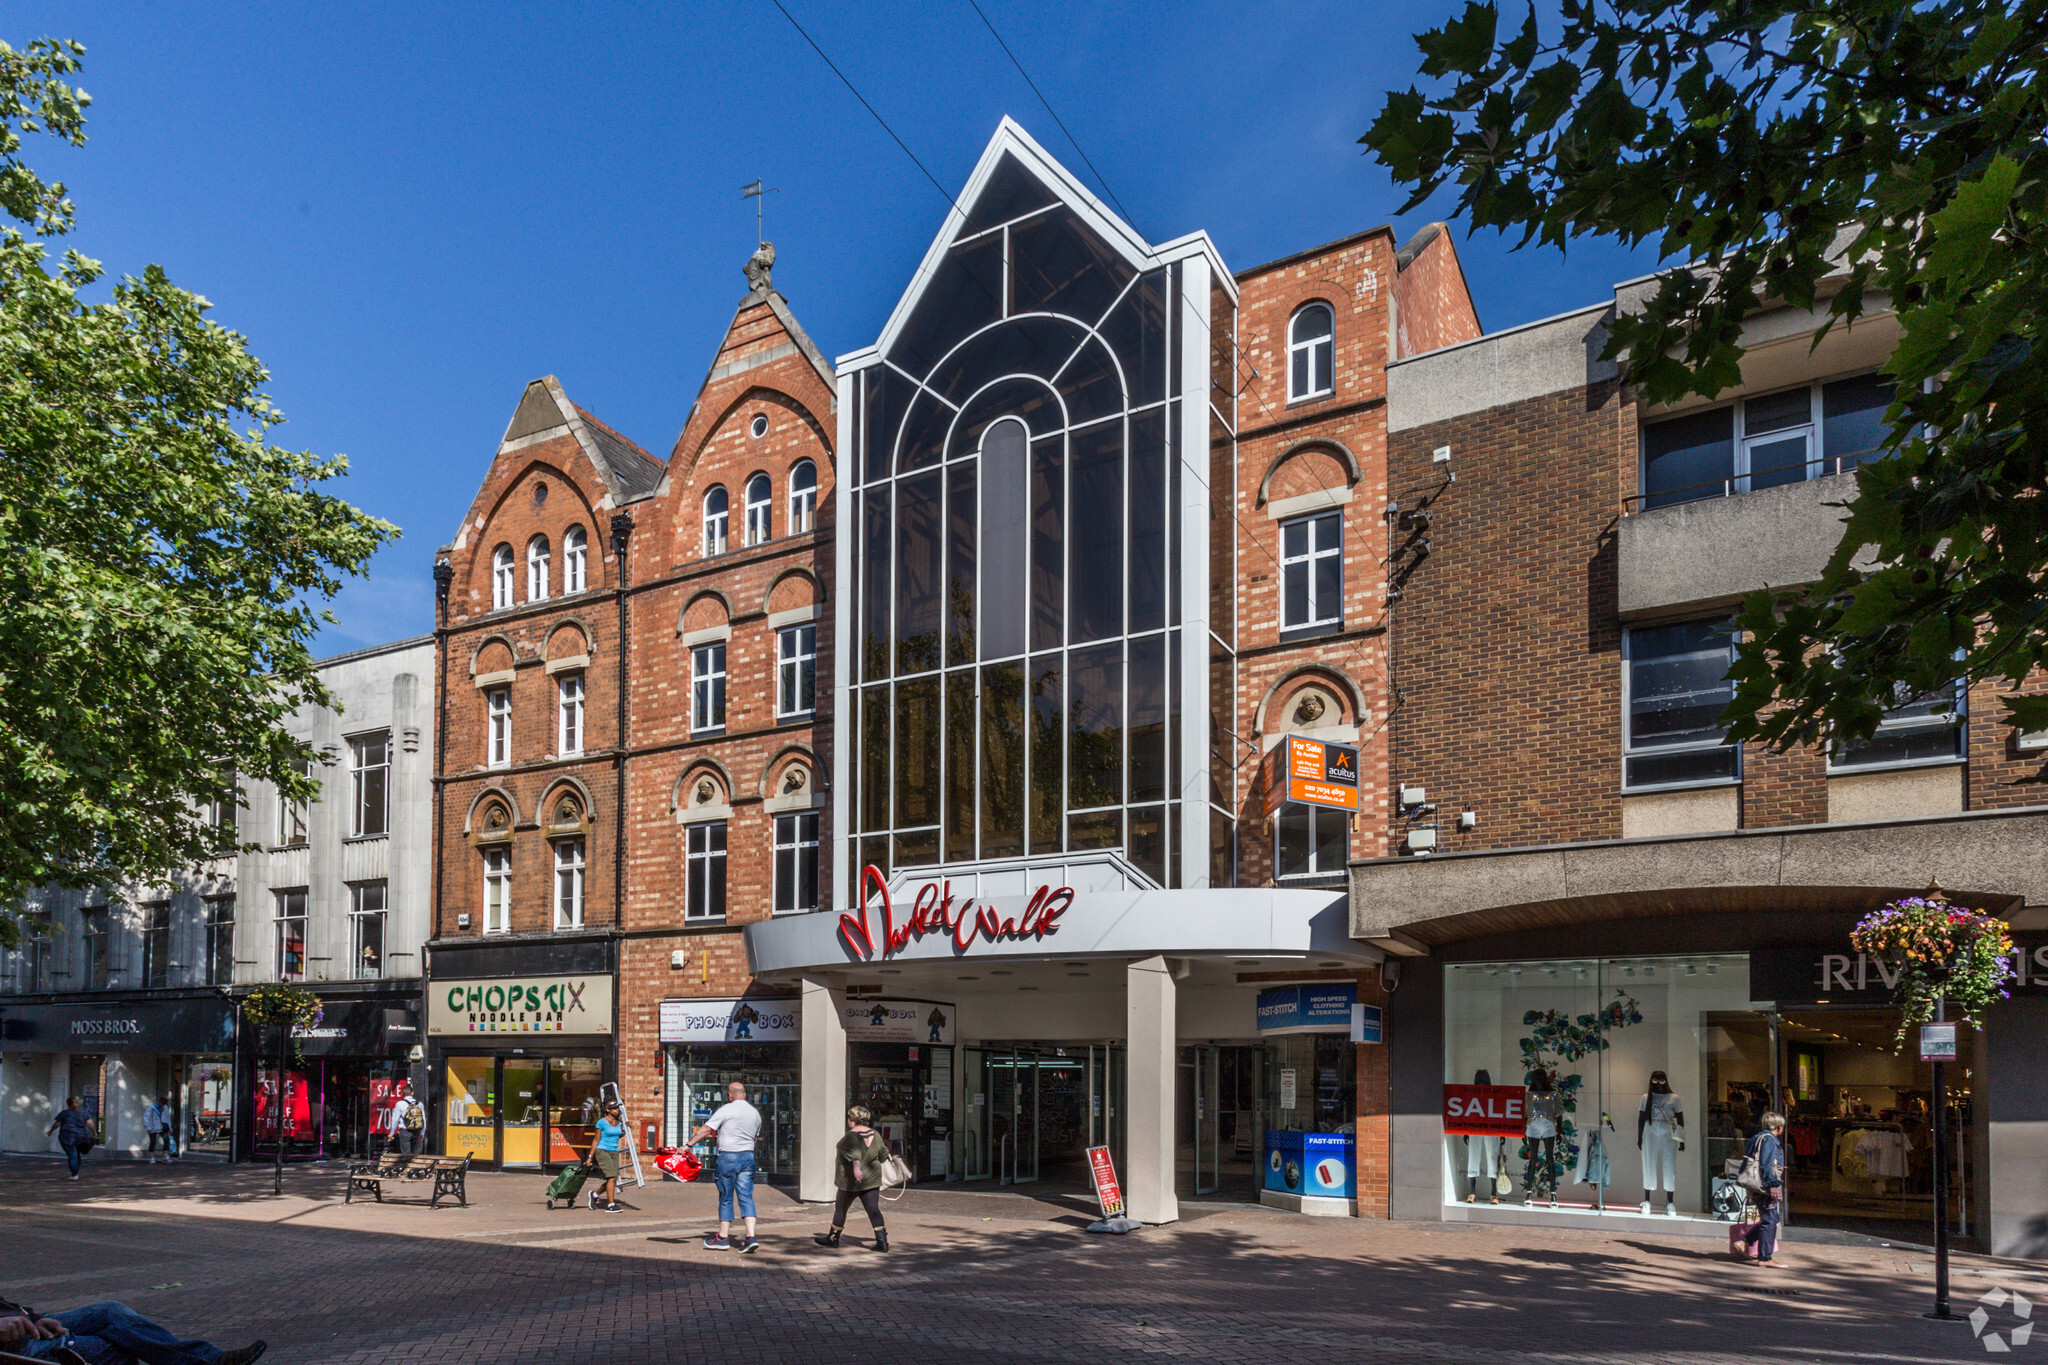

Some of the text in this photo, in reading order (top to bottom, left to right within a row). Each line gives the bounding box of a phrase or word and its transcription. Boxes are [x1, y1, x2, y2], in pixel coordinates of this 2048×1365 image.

[1293, 741, 1322, 754] For Sale
[1329, 767, 1355, 779] acuitus
[839, 864, 1075, 957] Market Walk
[1822, 951, 1901, 992] RIV
[448, 981, 585, 1013] CHOPSTIX
[846, 1008, 917, 1019] ONE BOX
[1258, 1002, 1298, 1017] FAST-STITCH
[469, 1011, 563, 1023] NOODLE BAR
[685, 1015, 733, 1030] PHONE
[759, 1014, 795, 1029] BOX
[71, 1019, 103, 1034] MOSS
[263, 1080, 294, 1095] SAE
[377, 1084, 401, 1098] SALE
[268, 1106, 291, 1118] HAF
[1447, 1096, 1523, 1119] SALE
[266, 1118, 295, 1129] PRCE
[377, 1107, 394, 1130] 70
[1447, 1121, 1522, 1131] CONTINUES INSTORE
[1308, 1137, 1354, 1145] FAST-STITCH
